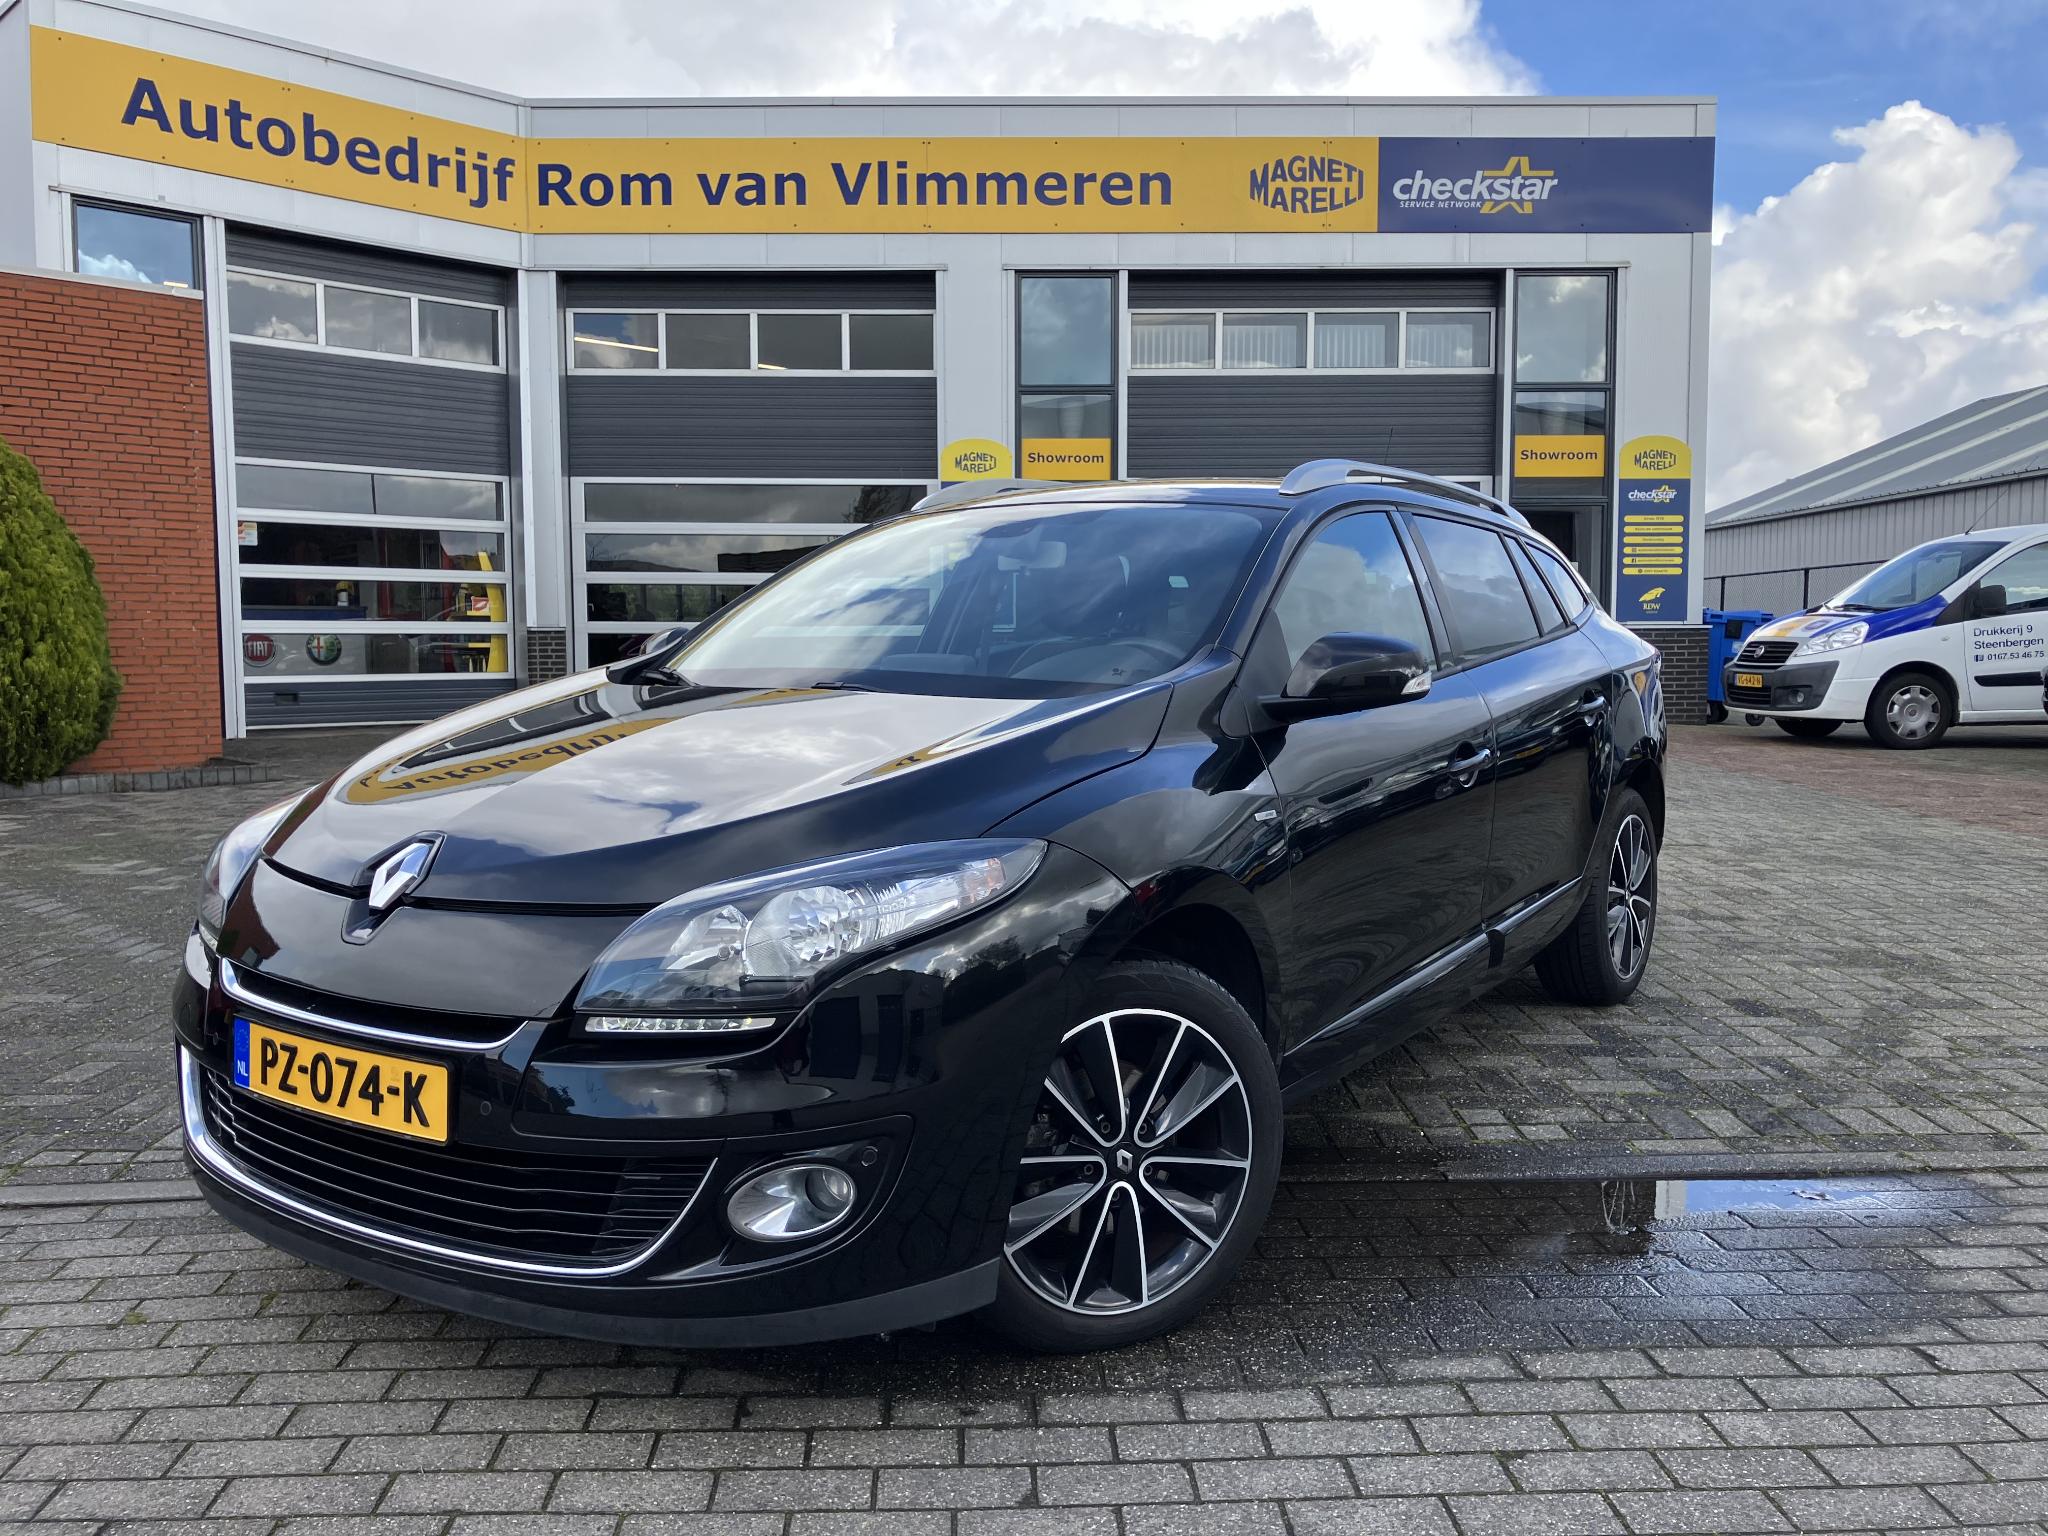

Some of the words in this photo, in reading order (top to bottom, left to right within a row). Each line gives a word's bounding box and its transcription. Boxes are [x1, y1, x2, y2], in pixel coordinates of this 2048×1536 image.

[121, 77, 515, 209] Autobedrijf
[538, 163, 673, 207] Rom
[697, 171, 807, 207] van
[831, 161, 1172, 207] Vlimmeren
[1250, 155, 1364, 192] MAGNETI
[1392, 169, 1559, 201] checkstar
[1250, 181, 1364, 214] MARELLI
[1400, 200, 1434, 208] SERVICE
[1438, 200, 1482, 208] NETWORK
[955, 451, 997, 465] MAGNETI
[1027, 452, 1104, 464] Showroom
[1520, 449, 1598, 460] Showroom
[1634, 449, 1677, 462] MAGNETI
[955, 460, 997, 474] MARELLI
[1634, 458, 1677, 471] MARELLI
[1628, 489, 1677, 499] checkstar
[1974, 625, 2023, 637] Drukkerij
[2026, 624, 2033, 633] 9
[247, 640, 269, 657] FIAT
[1974, 638, 2044, 650] Steenbergen
[2010, 652, 2020, 660] 53
[2034, 650, 2045, 658] 75
[237, 1059, 249, 1077] NL
[260, 1036, 431, 1128] PZ-074-K
